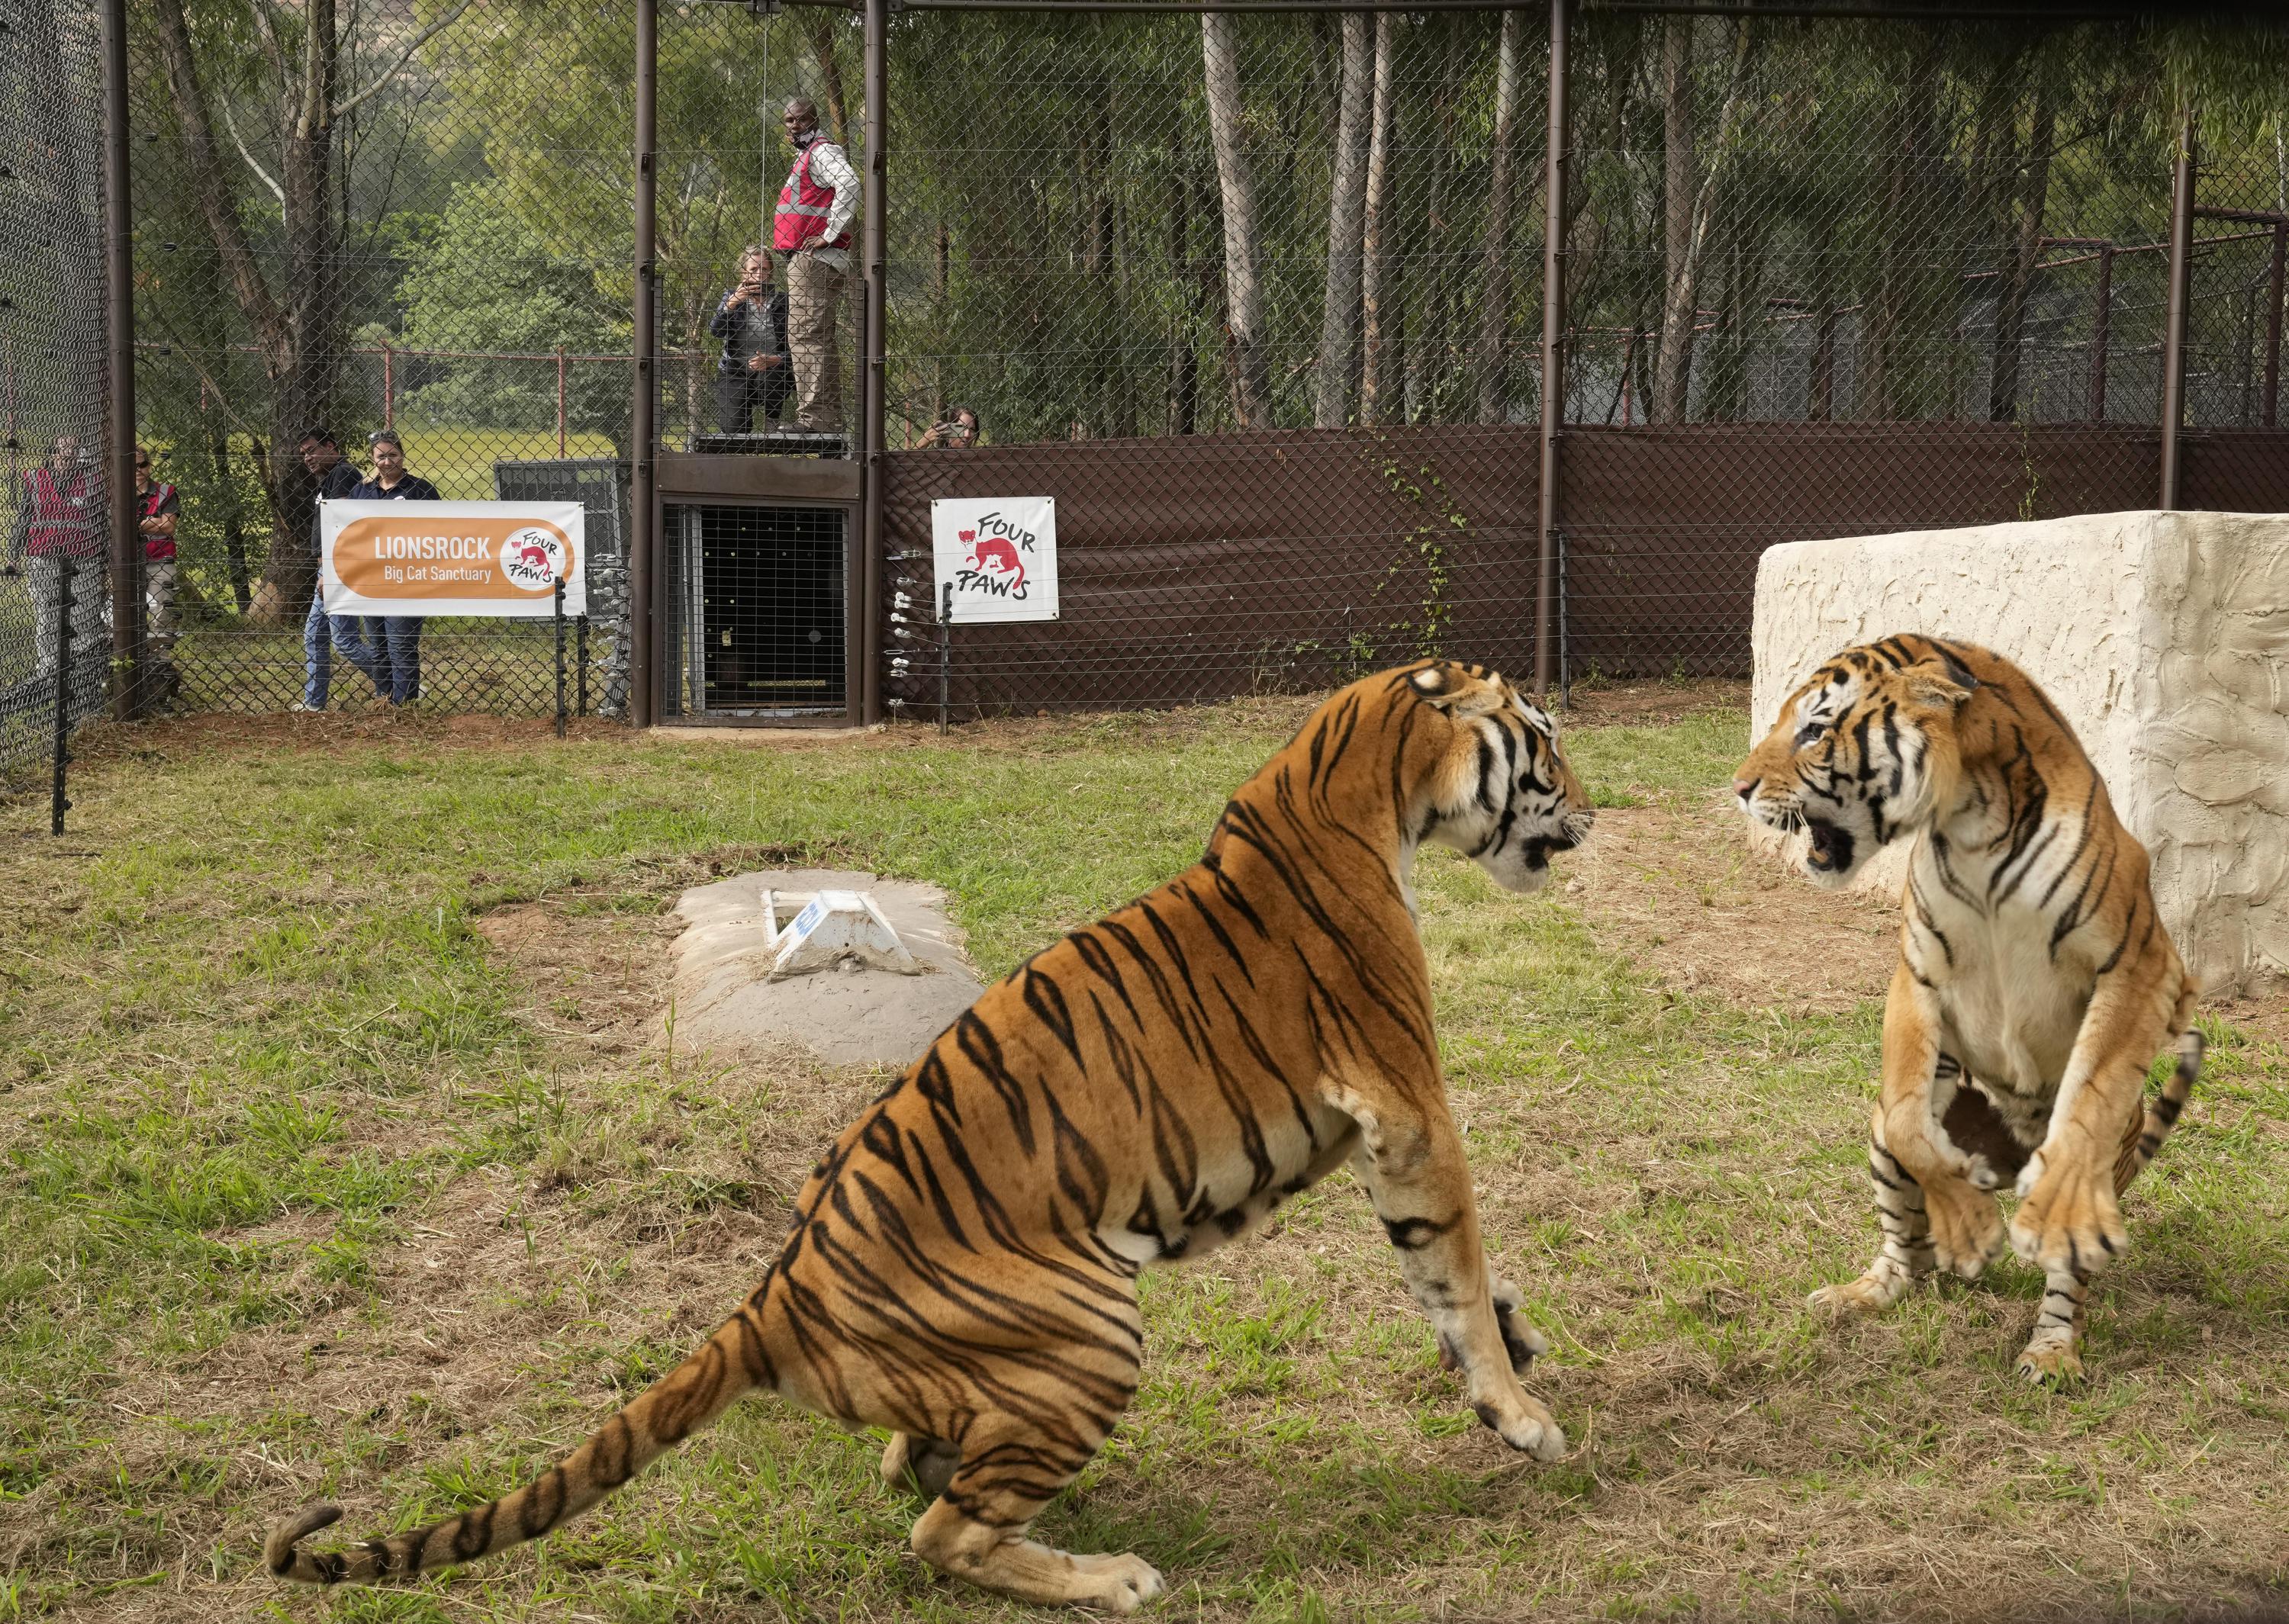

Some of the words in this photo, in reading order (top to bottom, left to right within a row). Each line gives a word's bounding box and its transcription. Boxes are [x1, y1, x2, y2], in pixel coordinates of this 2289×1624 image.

[523, 532, 558, 555] FOUR
[977, 512, 1035, 553] FOUR
[375, 536, 491, 559] LIONSROCK
[385, 565, 404, 584] Big
[407, 565, 427, 580] Cat
[430, 566, 491, 584] Sanctuary
[509, 564, 554, 583] PAWS
[955, 570, 1031, 600] PAWS
